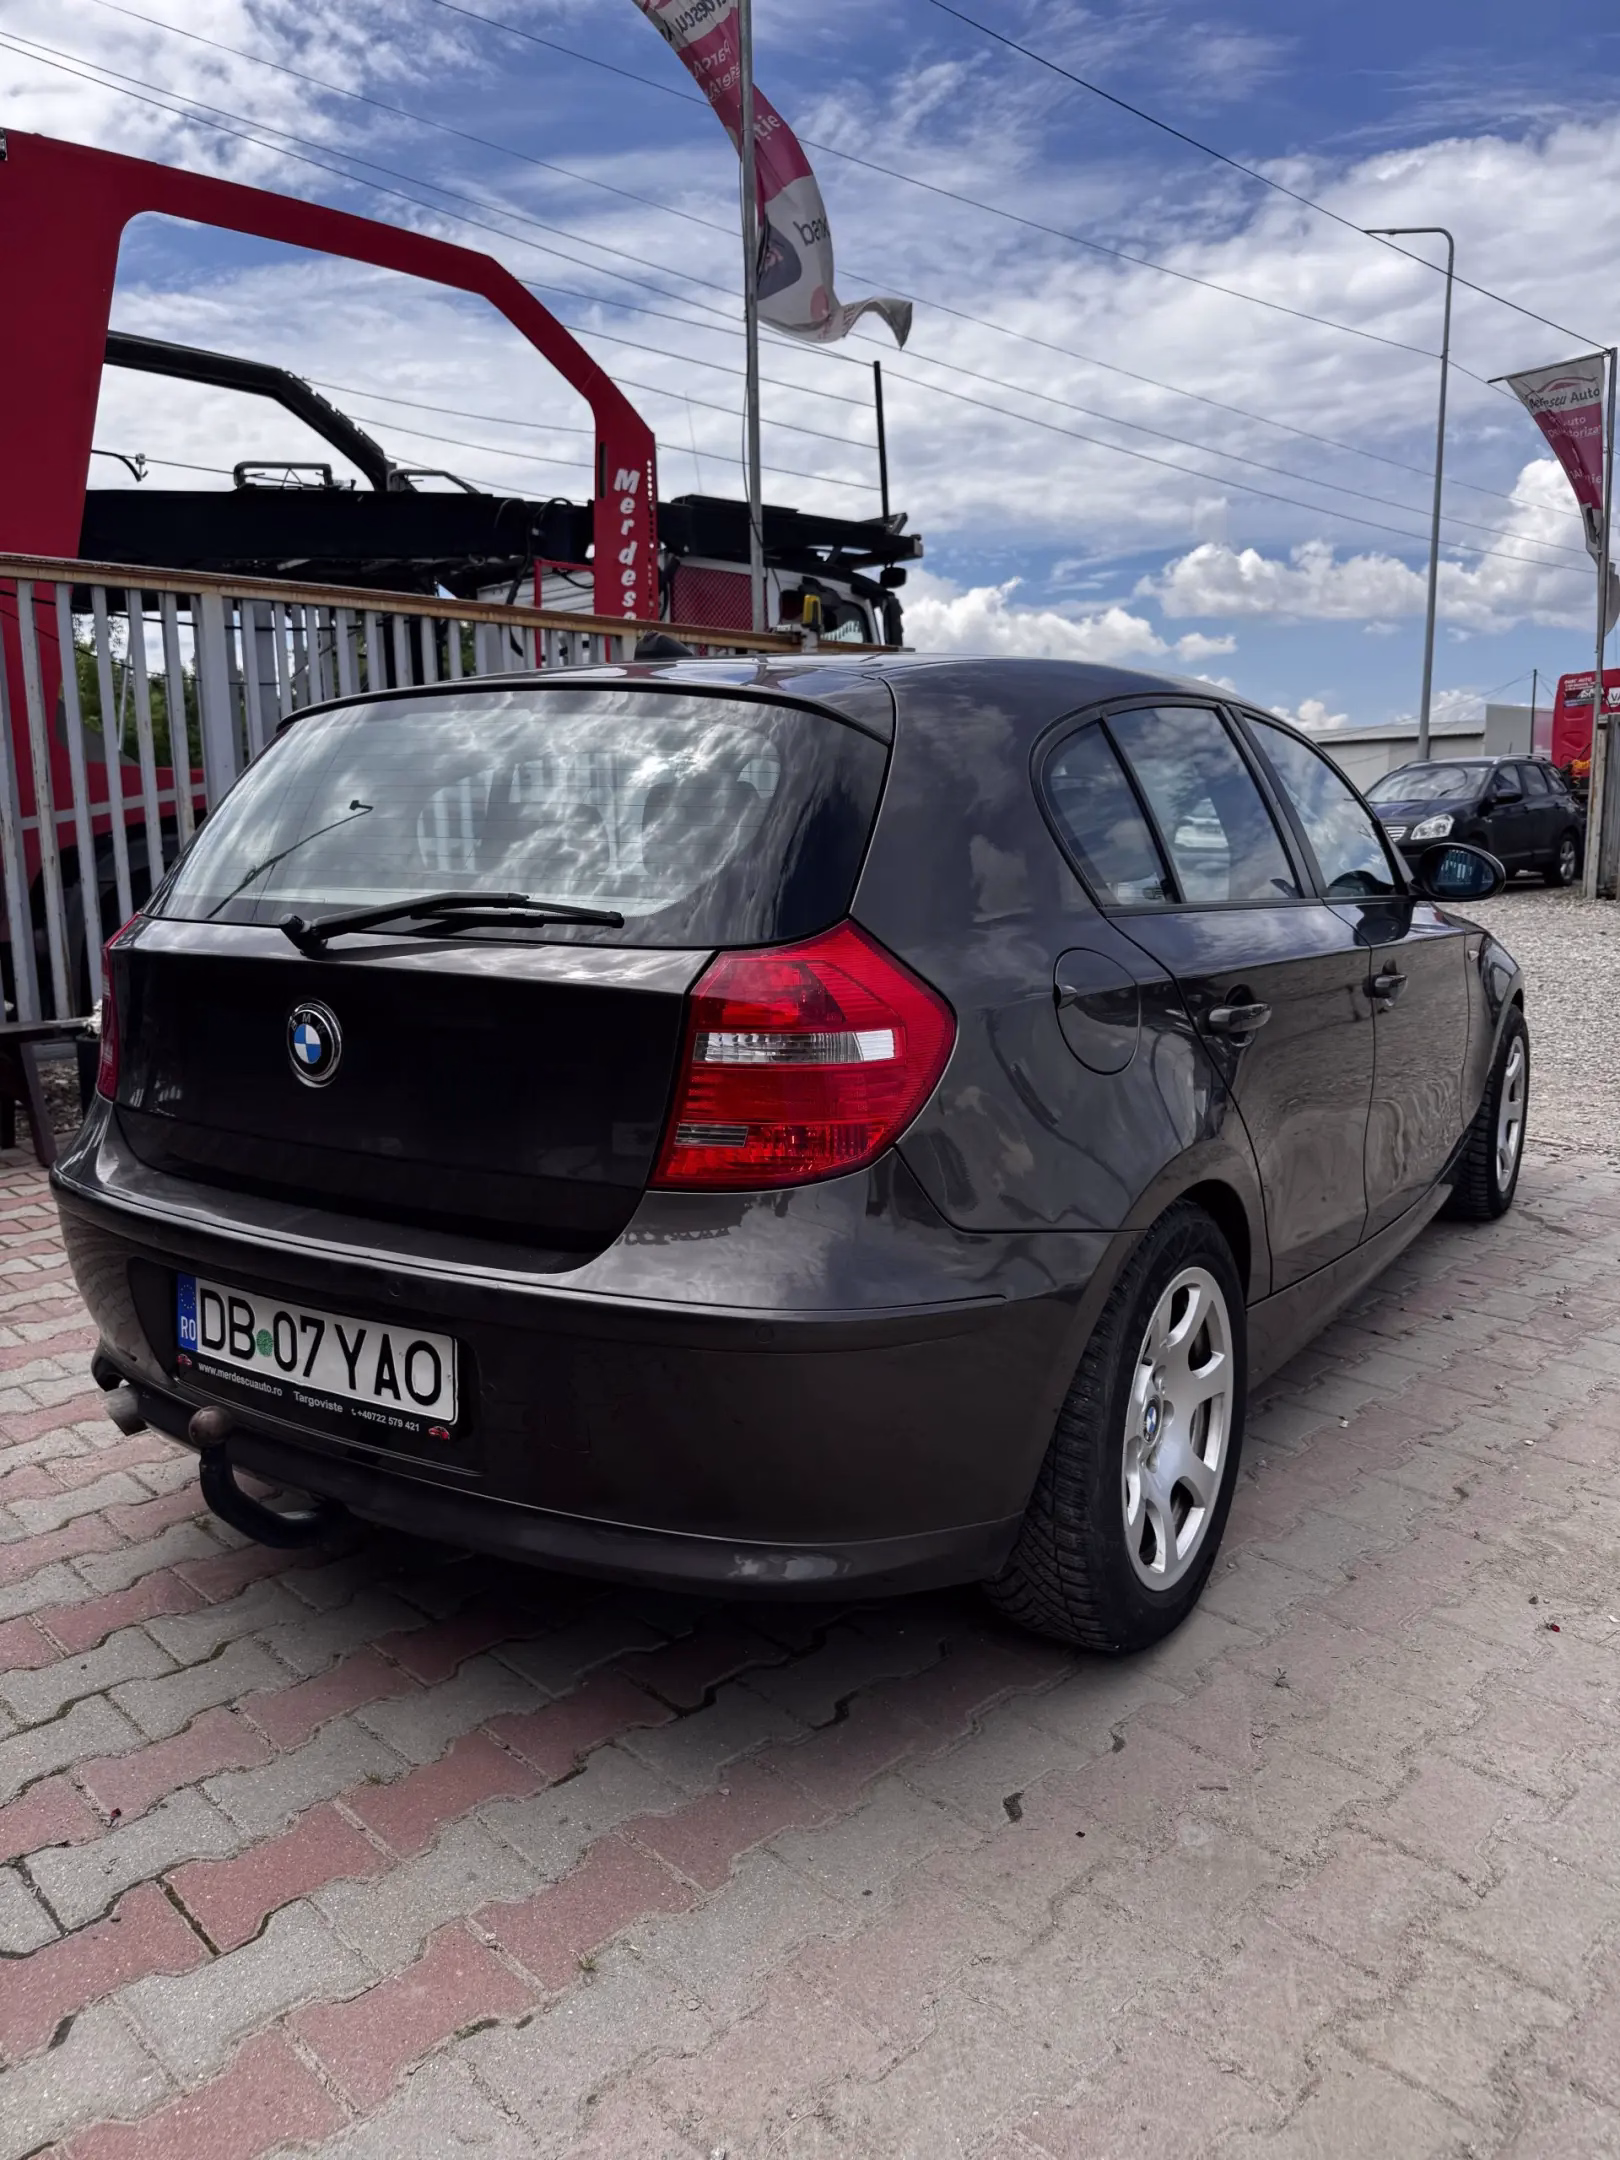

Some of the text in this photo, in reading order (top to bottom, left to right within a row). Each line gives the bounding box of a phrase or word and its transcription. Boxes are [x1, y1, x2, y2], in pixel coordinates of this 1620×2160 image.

[1570, 387, 1600, 404] Auto
[180, 1315, 197, 1341] RO
[200, 1287, 442, 1406] DB 07 YAO
[198, 1362, 420, 1432] www.merdescuauto.ro Targoviste +40722 579 421
